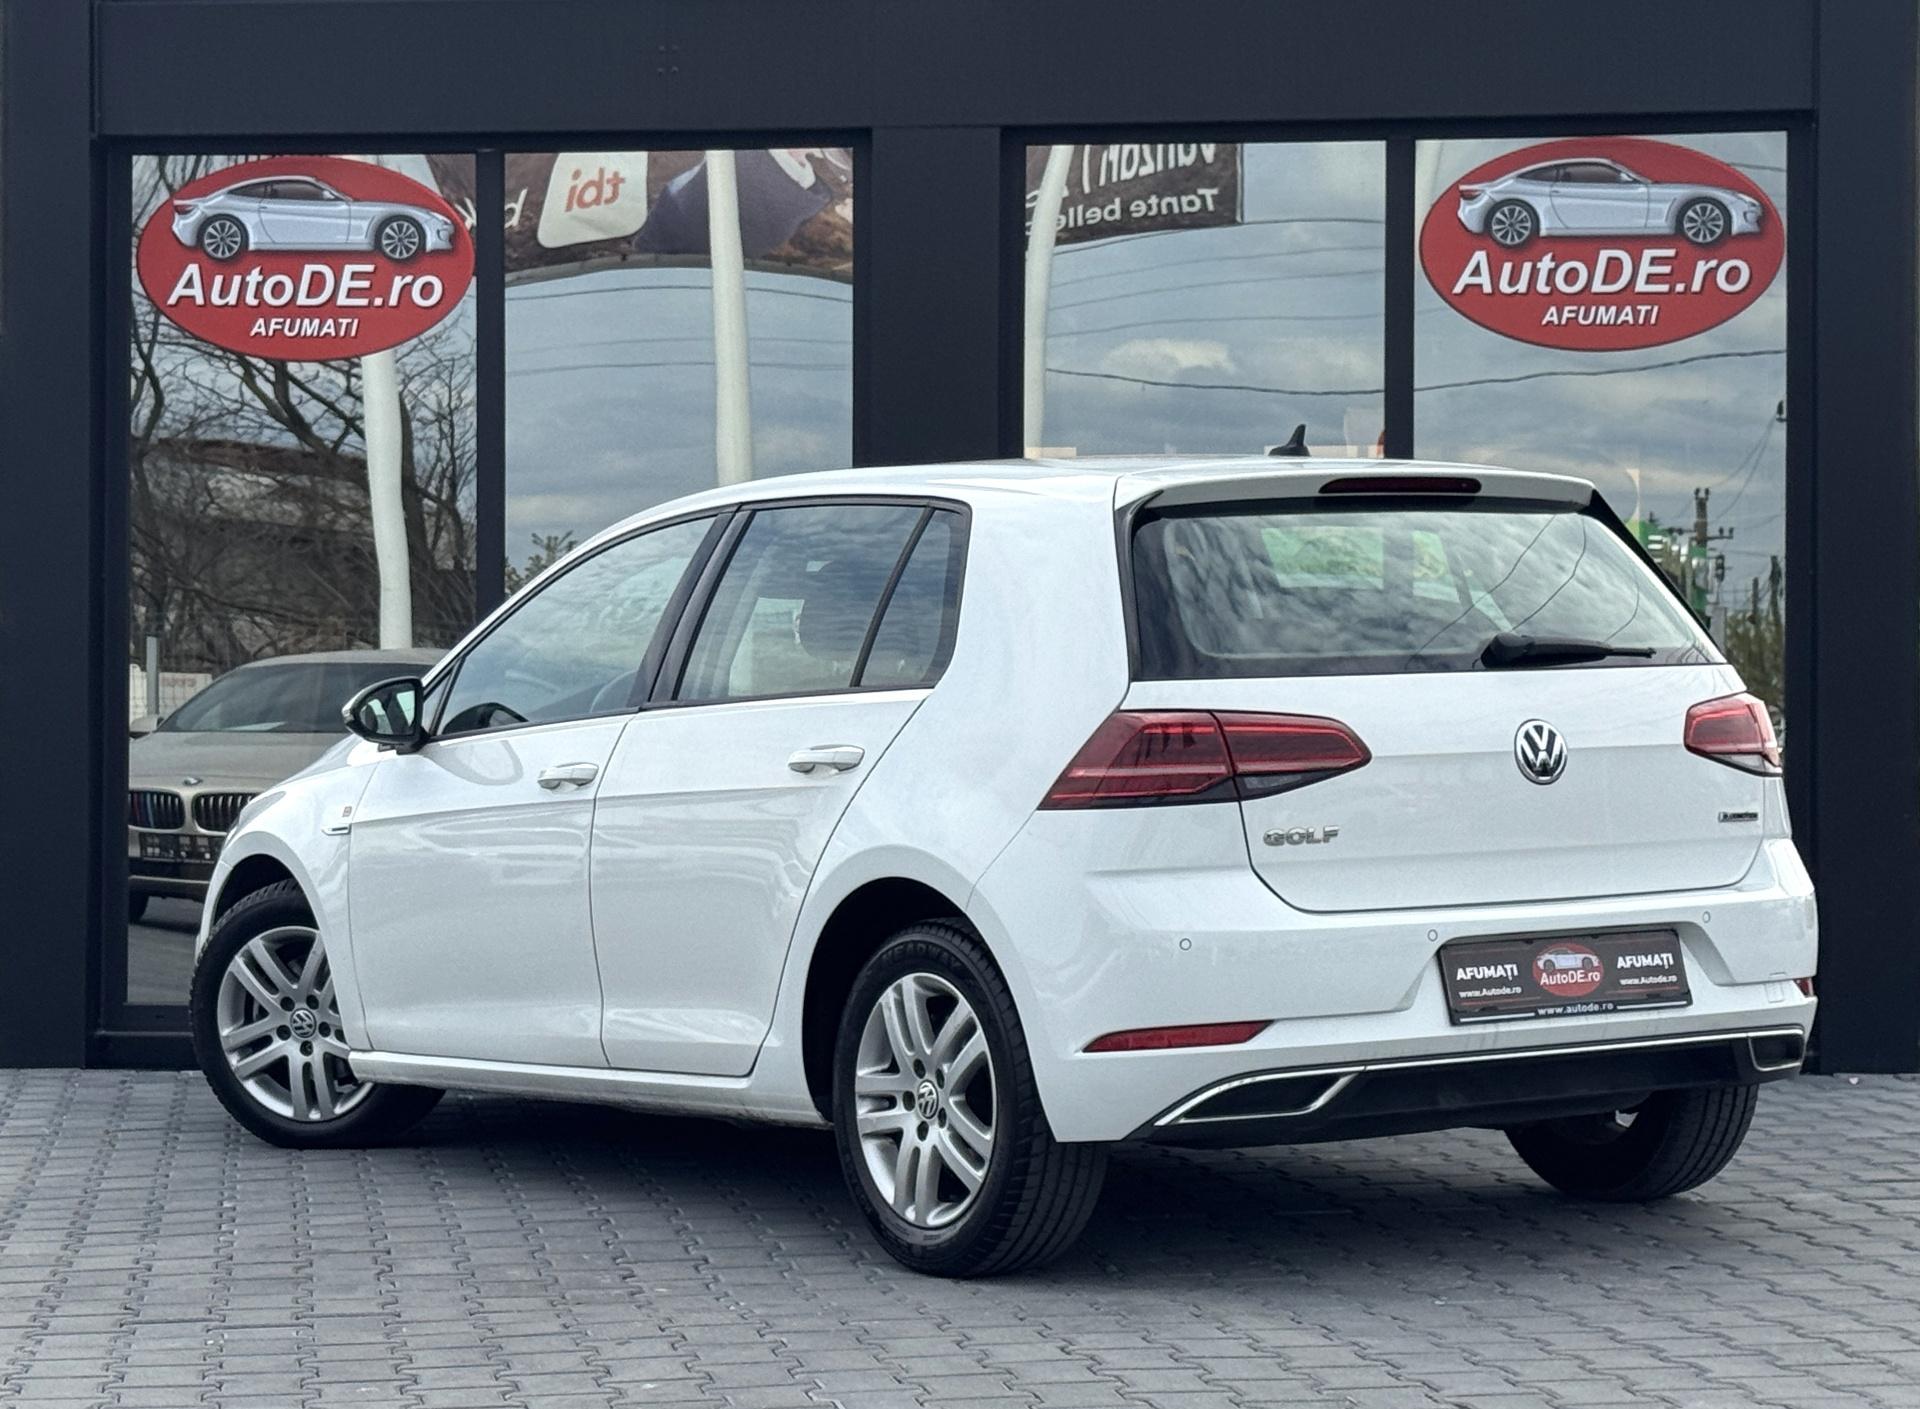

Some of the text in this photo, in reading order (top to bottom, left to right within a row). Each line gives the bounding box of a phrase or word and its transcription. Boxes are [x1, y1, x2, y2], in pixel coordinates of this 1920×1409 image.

[1452, 247, 1751, 295] AutoDE.ro
[166, 263, 444, 309] AutoDE.ro
[1541, 305, 1659, 326] AFUMATI
[250, 317, 360, 338] AFUMATI
[1263, 825, 1340, 846] GOLF
[1540, 970, 1601, 986] AutoDE.ro
[1537, 1002, 1614, 1015] www.autode.ro
